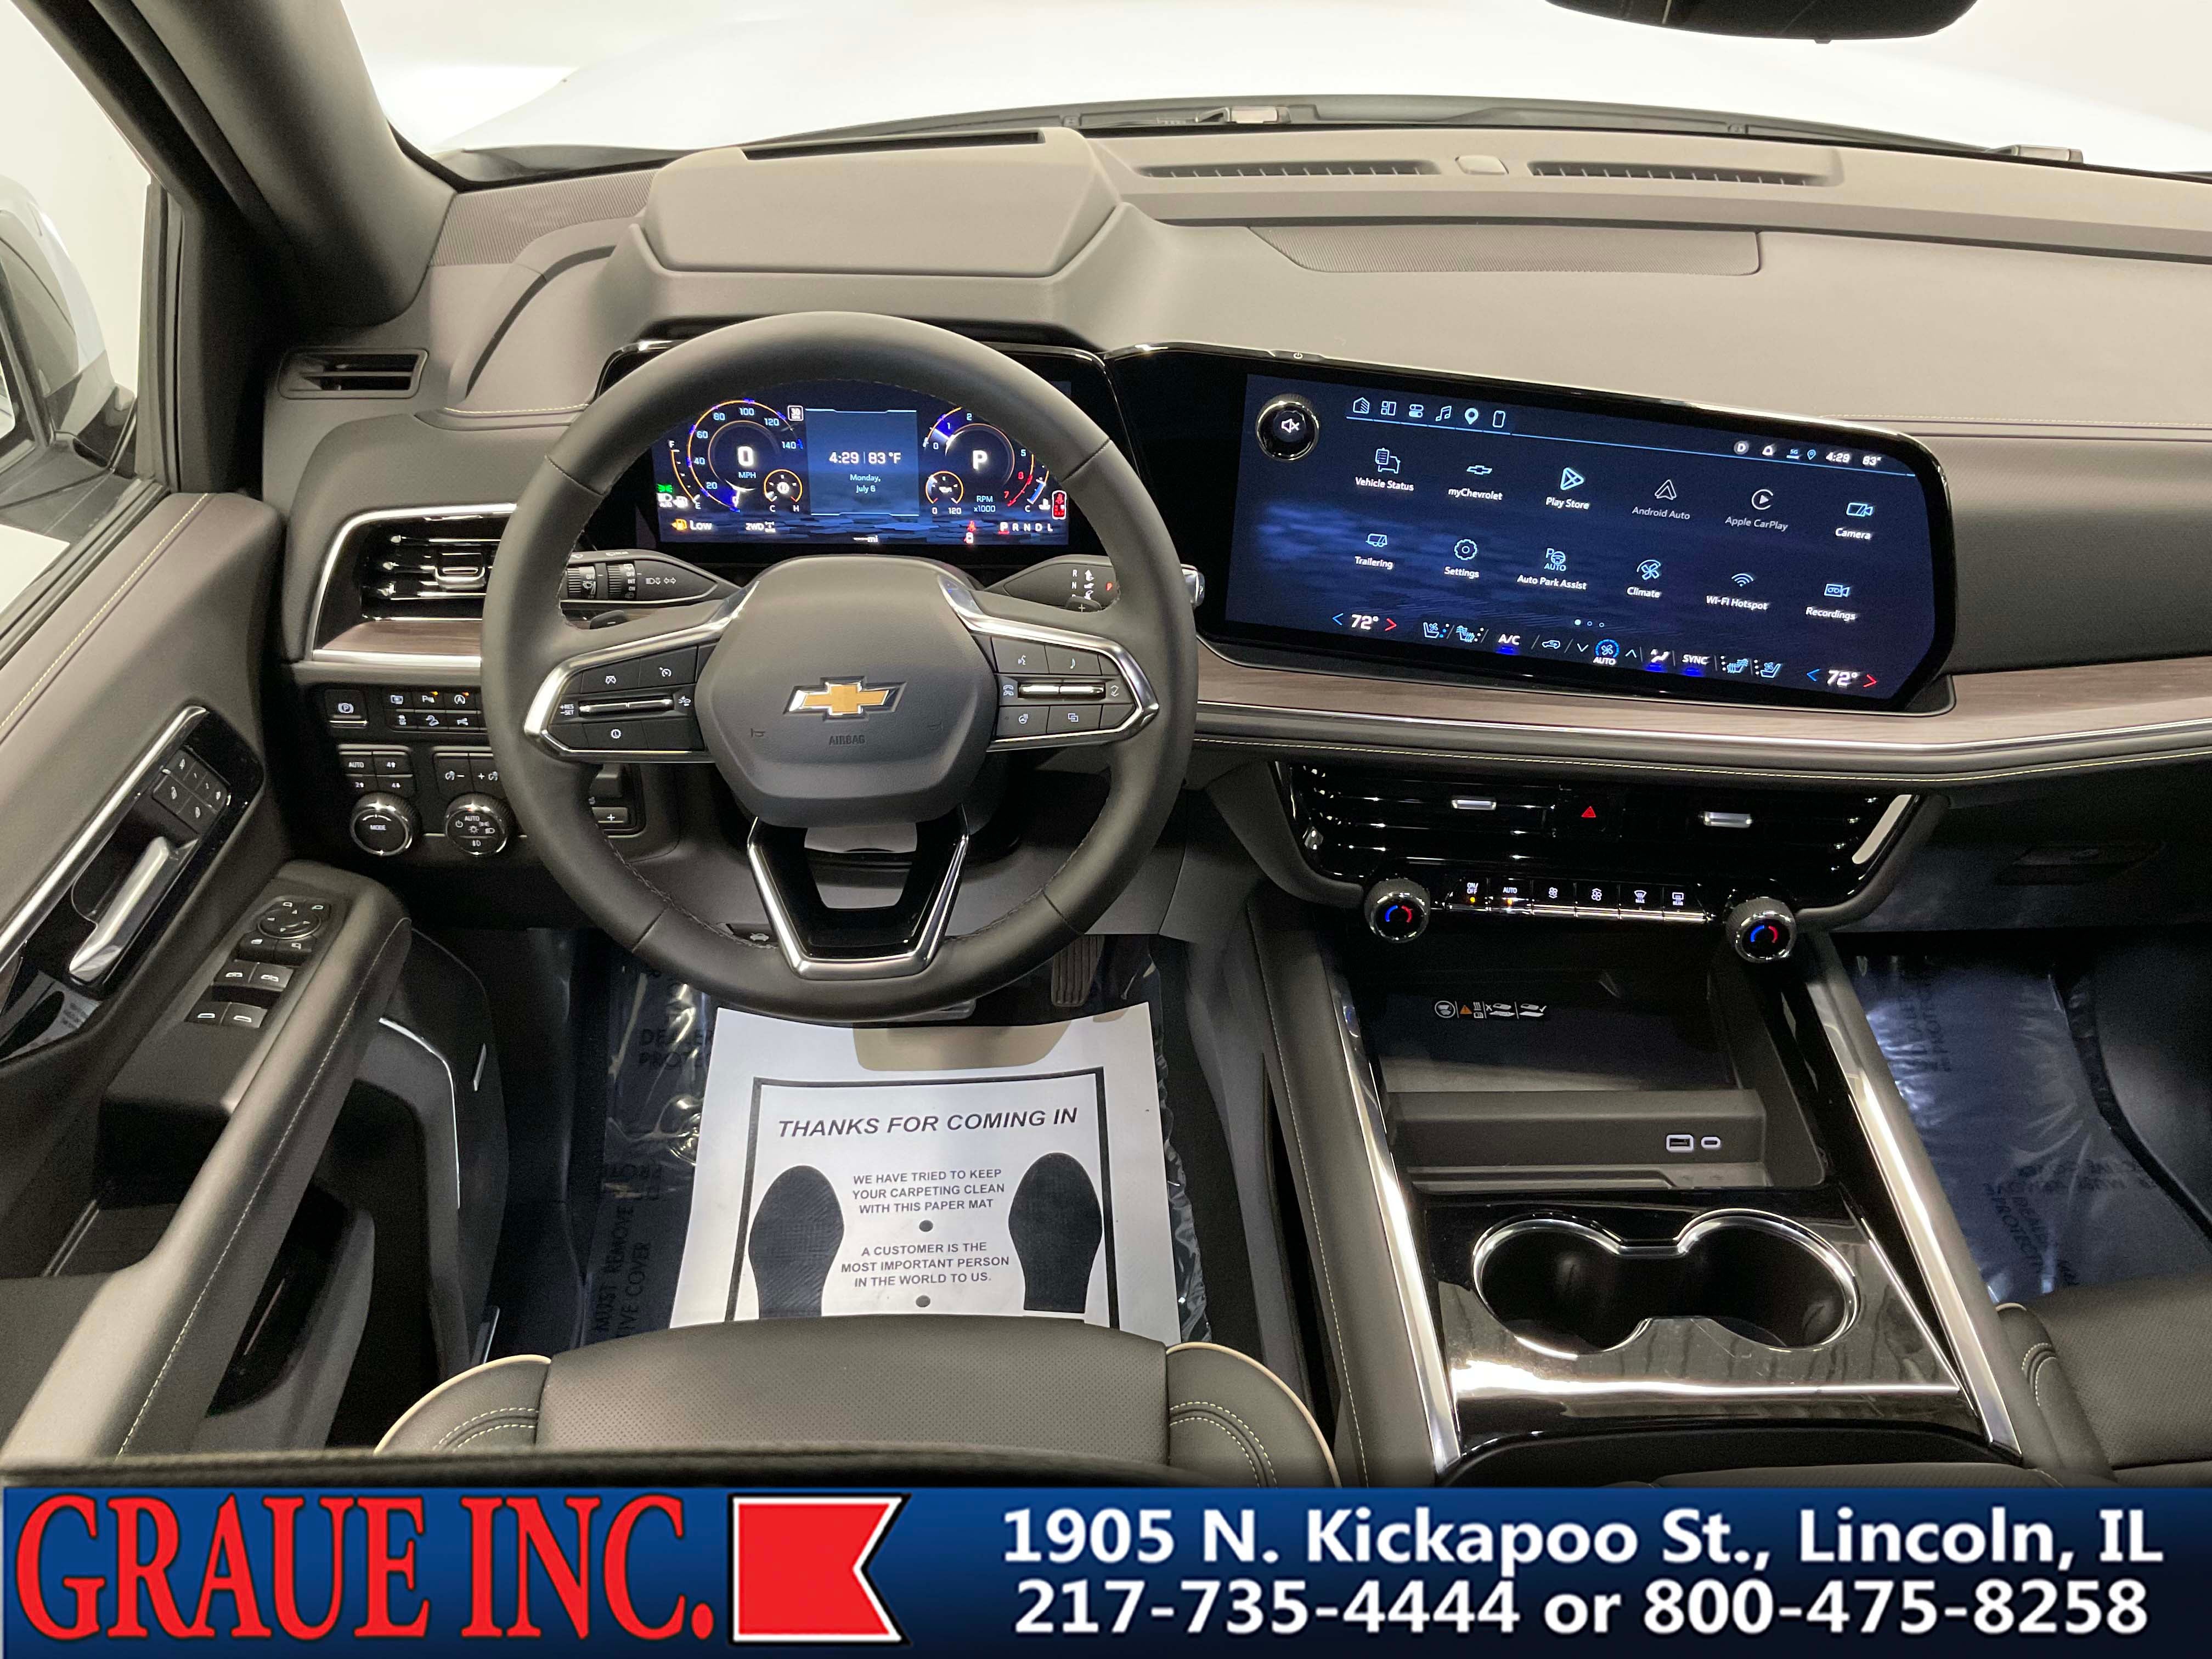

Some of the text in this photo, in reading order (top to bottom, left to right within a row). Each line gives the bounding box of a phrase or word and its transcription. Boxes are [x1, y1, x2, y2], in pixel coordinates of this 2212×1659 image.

[713, 413, 725, 421] 80
[738, 447, 753, 466] 0
[829, 452, 859, 464] 4:29
[868, 452, 885, 464] 83
[973, 450, 987, 469] P
[1825, 452, 1850, 463] 4:29
[850, 473, 881, 483] Monday,
[1355, 477, 1414, 491] Vehicle Status
[856, 485, 869, 493] July
[1448, 487, 1503, 501] myChevrolet
[1546, 497, 1589, 509] Play Store
[1632, 506, 1690, 520] Android Auto
[690, 520, 712, 530] Low
[1000, 522, 1053, 532] P R N D L
[1725, 517, 1788, 531] Apple CarPlay
[1835, 528, 1872, 540] Camera
[1355, 556, 1393, 569] Trailering
[1544, 563, 1566, 572] AUTO
[1444, 567, 1480, 579] Settings
[1517, 575, 1587, 589] Auto Park Assist
[1627, 587, 1661, 598] Climate
[1731, 597, 1768, 611] Hotspot
[1805, 607, 1856, 620] Recordings
[1498, 634, 1520, 645] A/C
[1593, 657, 1616, 665] AUTO
[1683, 654, 1709, 665] SYNC
[829, 735, 865, 745] AIRBAG
[780, 1108, 1077, 1137] THANKS FOR COMING IN
[854, 1169, 1001, 1184] WE HAVE TRIED TO KEEP
[853, 1184, 1004, 1199] YOUR CARPETING CLEAN
[860, 1199, 993, 1214] WITH THIS PAPER MAT
[861, 1242, 986, 1256] A CUSTOMER IS THE
[842, 1256, 1009, 1272] MOST IMPORTANT PERSON
[855, 1272, 991, 1287] IN THE WORLD TO US.
